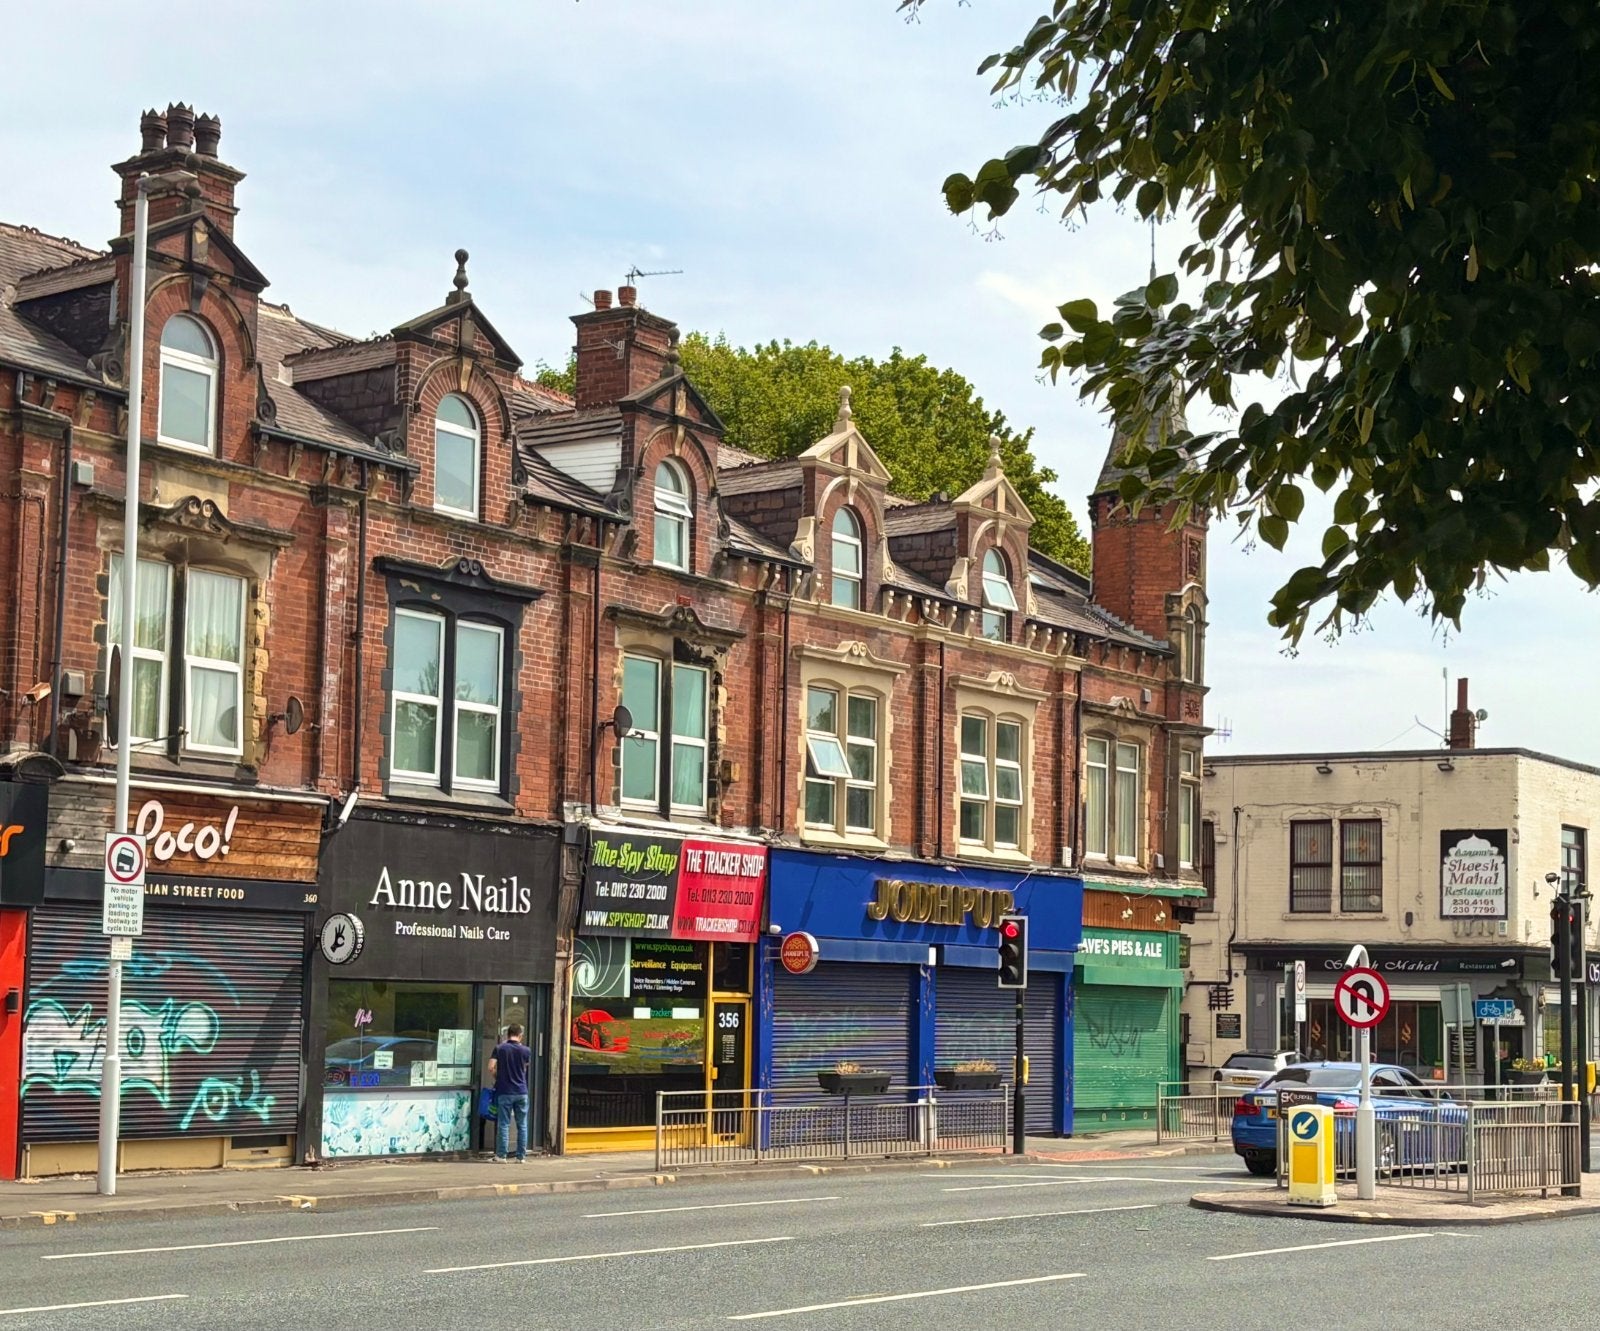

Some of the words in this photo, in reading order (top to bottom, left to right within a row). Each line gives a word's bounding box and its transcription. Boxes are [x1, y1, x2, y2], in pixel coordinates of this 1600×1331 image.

[136, 800, 238, 864] Poco!
[592, 840, 618, 867] The
[617, 842, 644, 874] Spy
[643, 845, 678, 876] Shop
[686, 849, 703, 873] THE
[704, 850, 742, 876] TRACKER
[741, 853, 765, 878] SHOP
[1448, 858, 1499, 872] Sheesh
[1448, 872, 1499, 885] Mahal
[110, 886, 119, 894] No
[121, 887, 138, 895] motor
[173, 885, 214, 898] STREET
[217, 888, 245, 899] FOOD
[369, 866, 453, 909] Anne
[459, 872, 531, 914] Nails
[611, 882, 628, 898] 0113
[629, 883, 646, 899] 230
[646, 885, 668, 901] 2000
[1444, 886, 1504, 897] Restaurant
[114, 894, 134, 902] vehicle
[303, 894, 318, 903] 360
[701, 889, 717, 904] 0113
[719, 890, 734, 905] 230
[734, 891, 754, 906] 2000
[868, 879, 1016, 929] JODHPUR
[108, 903, 130, 911] parking
[108, 910, 130, 918] loading
[107, 917, 130, 926] footway
[585, 910, 670, 929] WWW.SPYSHOP.CO.UK
[106, 924, 122, 933] cycle
[123, 924, 138, 932] track
[395, 920, 457, 939] Professional
[459, 925, 484, 940] Nails
[487, 927, 510, 940] Care
[1081, 938, 1110, 955] AVE'S
[1111, 939, 1133, 956] PIES
[1134, 940, 1143, 956] &
[1143, 942, 1163, 958] ALE
[630, 959, 667, 969] Surveillance
[670, 960, 703, 972] Equipment
[1384, 960, 1440, 971] Mahal
[718, 1012, 740, 1028] 356
